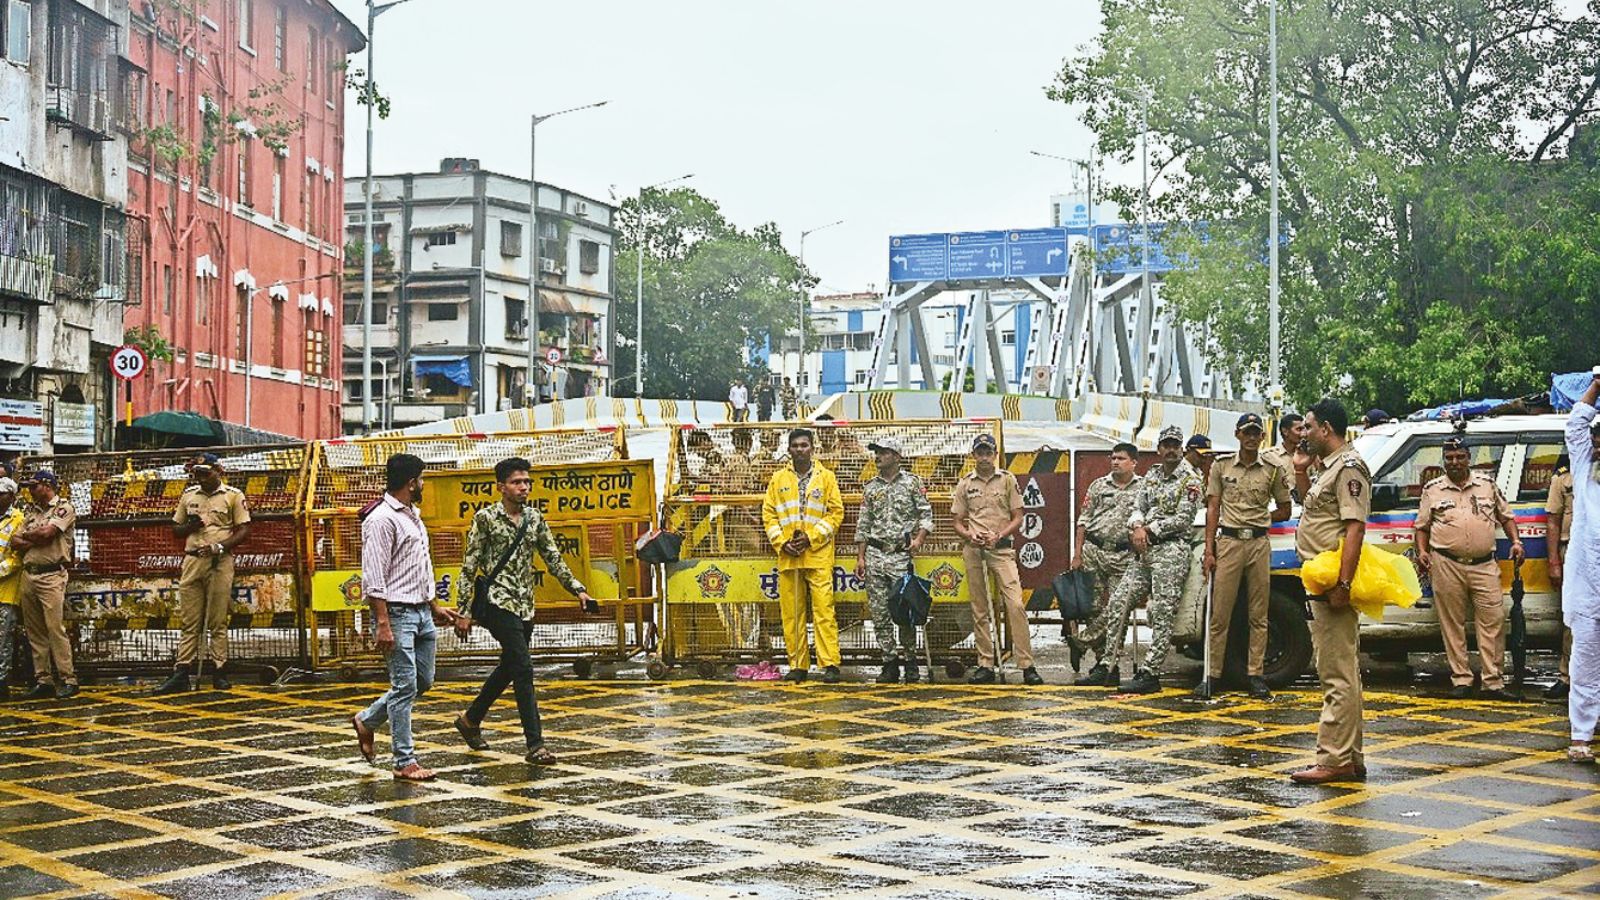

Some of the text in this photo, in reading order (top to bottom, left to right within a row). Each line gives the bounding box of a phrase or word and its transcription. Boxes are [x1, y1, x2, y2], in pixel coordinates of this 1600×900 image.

[117, 355, 139, 370] 30
[540, 471, 597, 492] पोलीस
[597, 467, 636, 491] ठाणे
[558, 493, 632, 512] POLICE
[1025, 514, 1038, 535] P
